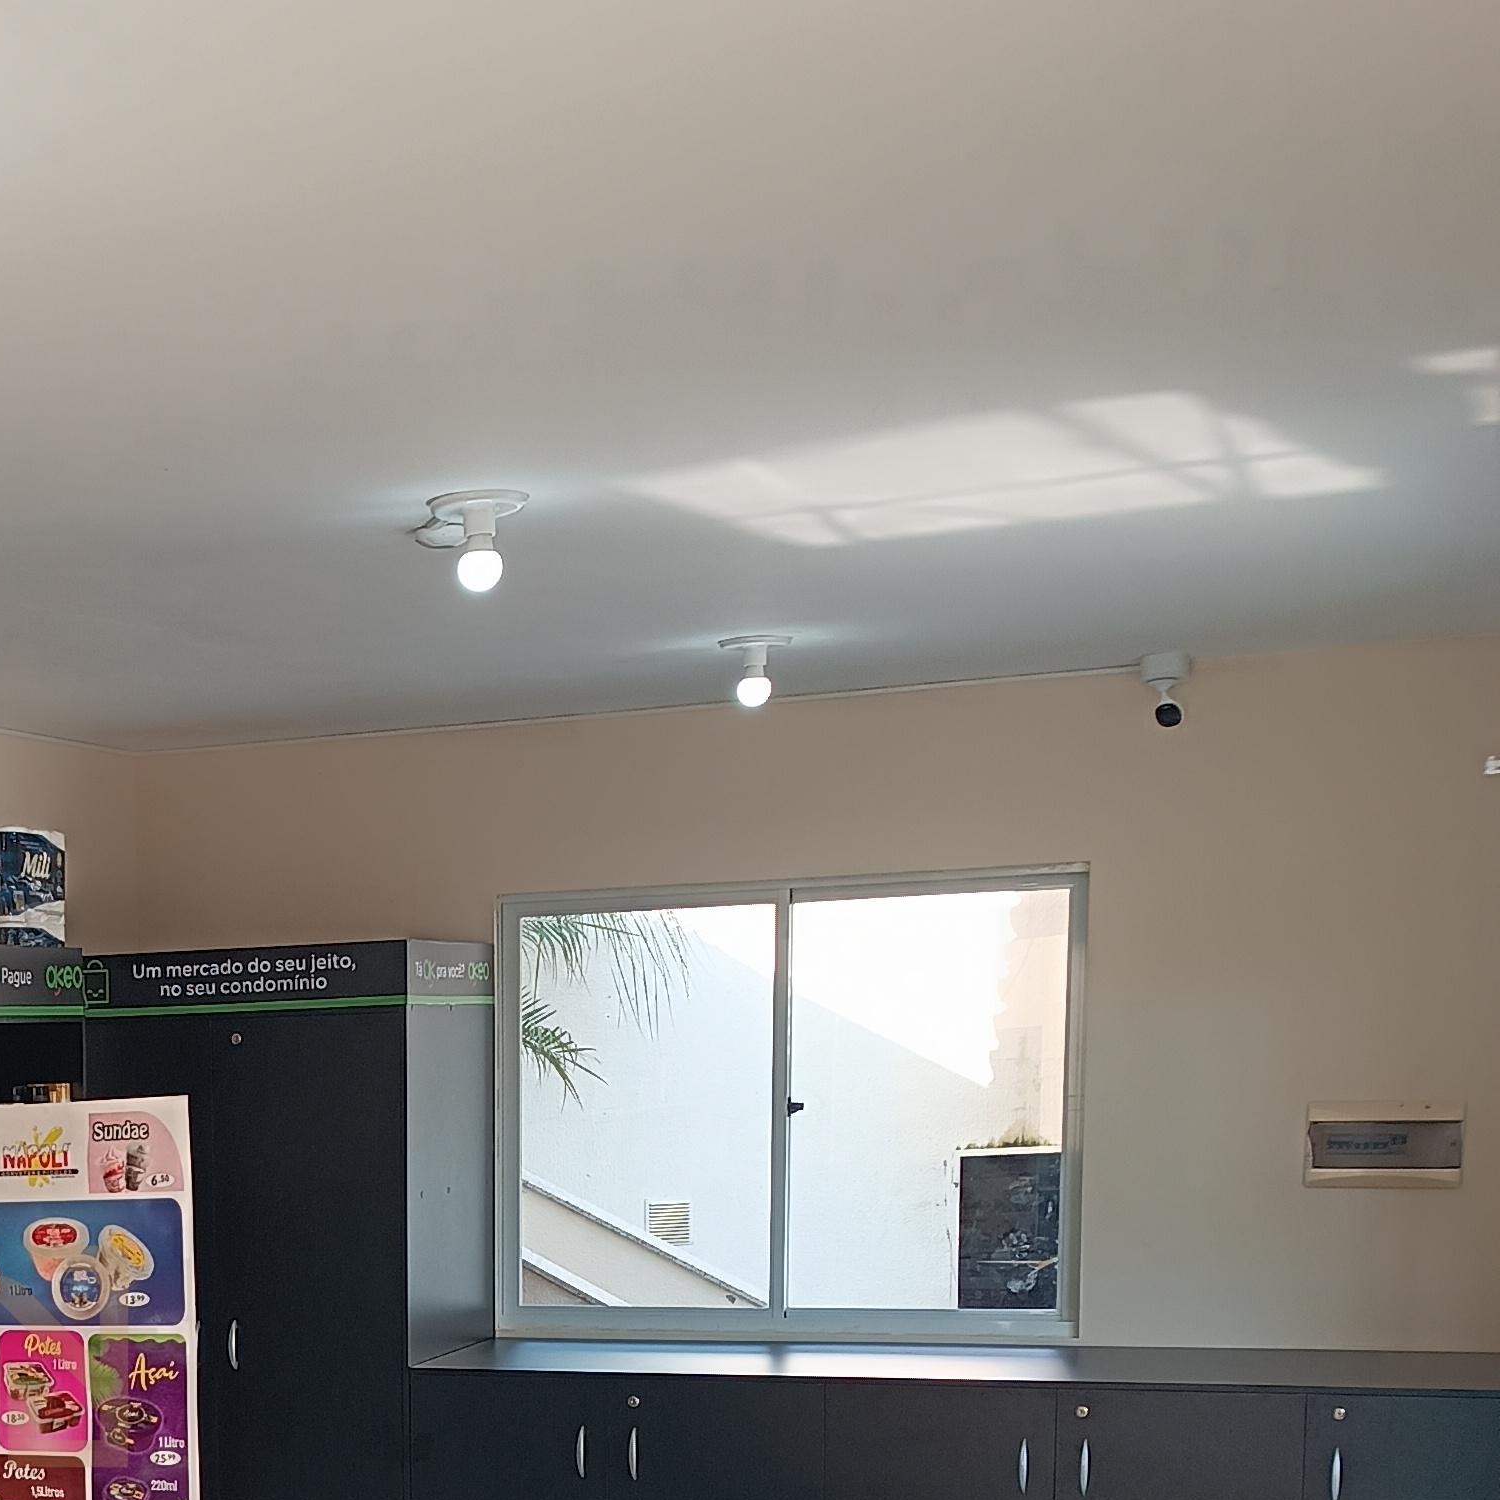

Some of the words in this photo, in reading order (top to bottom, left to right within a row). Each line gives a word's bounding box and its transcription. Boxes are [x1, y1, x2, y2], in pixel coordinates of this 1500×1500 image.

[23, 851, 50, 879] Mili
[1, 967, 32, 989] Pague
[132, 964, 161, 980] Um
[166, 959, 242, 978] mercado
[247, 957, 270, 974] do
[275, 959, 306, 973] seu
[309, 954, 357, 974] jeito,
[160, 984, 181, 997] no
[186, 982, 216, 996] seu
[219, 974, 328, 995] condomínio
[93, 1120, 150, 1142] Sundae
[3, 1142, 70, 1169] NAPOLI
[25, 1334, 62, 1357] Potes
[3, 1460, 46, 1481] Potes
